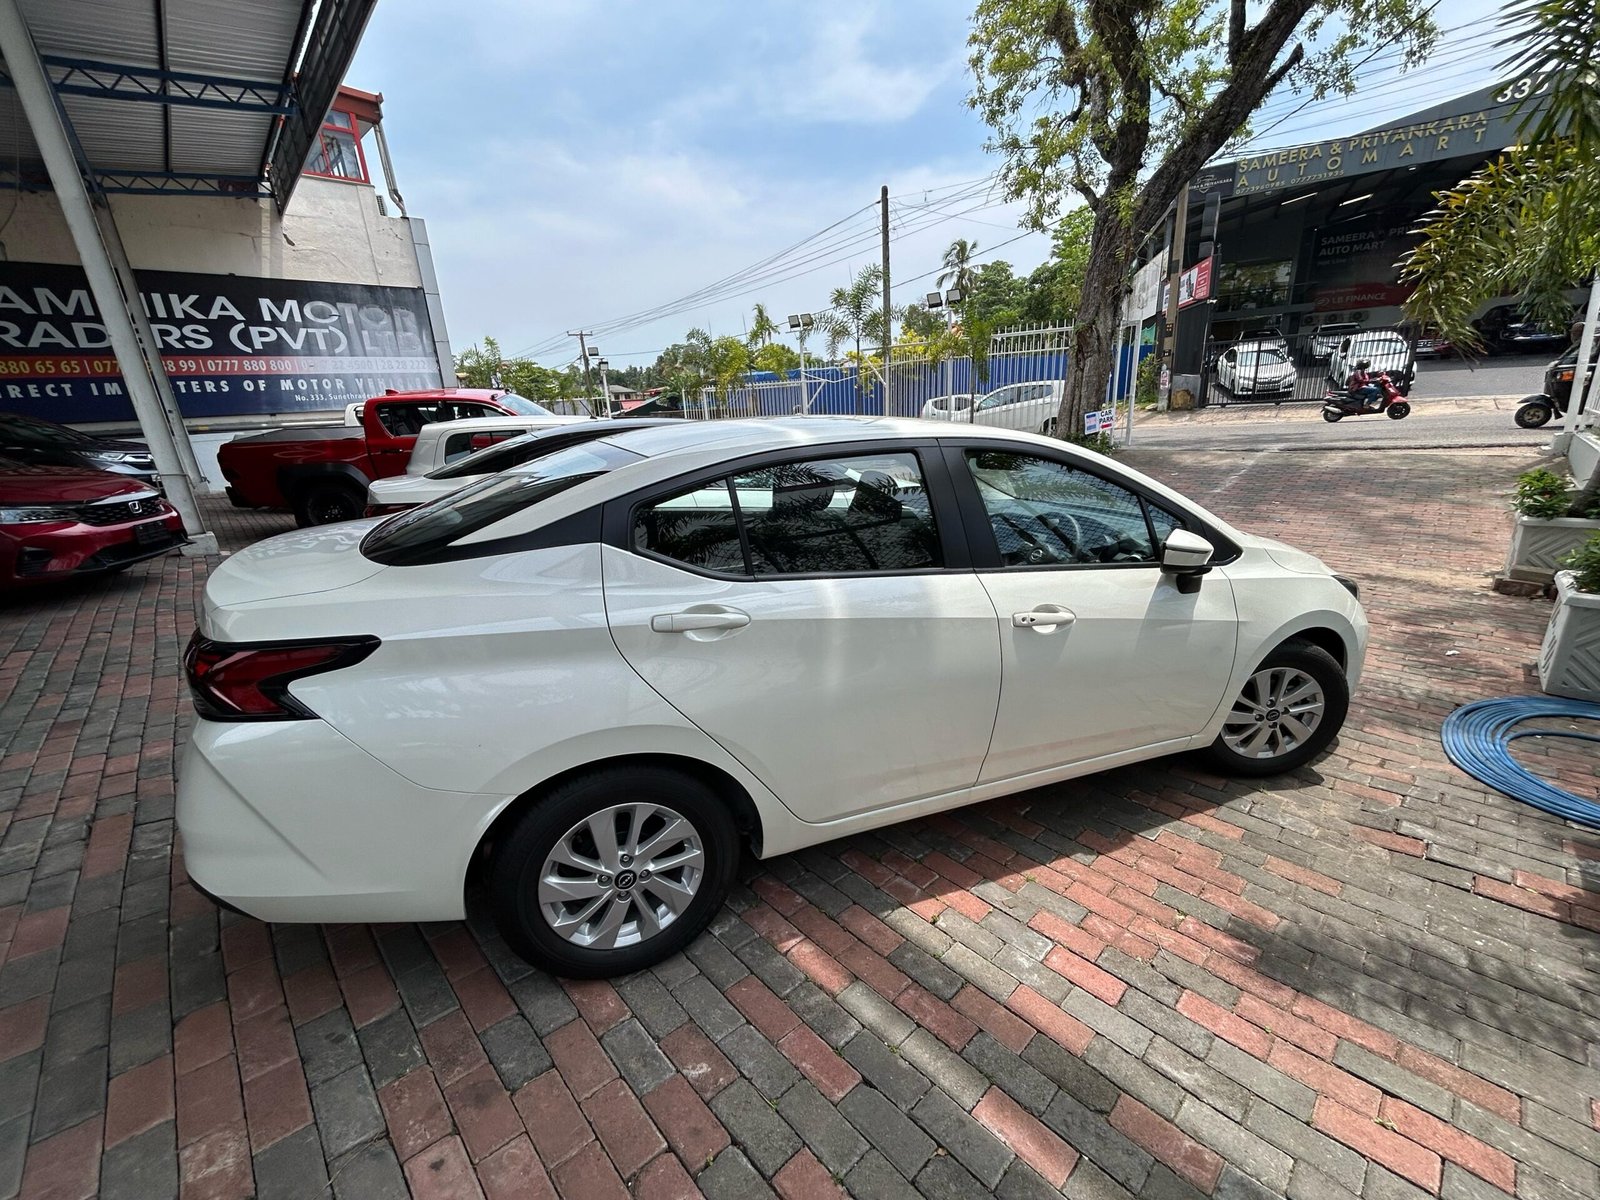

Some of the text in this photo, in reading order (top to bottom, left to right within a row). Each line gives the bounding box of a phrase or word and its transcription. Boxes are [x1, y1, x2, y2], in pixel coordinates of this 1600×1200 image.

[1239, 111, 1488, 173] SAMEERA & PRIYANKARA
[1237, 127, 1487, 188] AUTO MART
[1320, 230, 1376, 247] SAMEERA
[1319, 240, 1386, 257] AUTO MART
[1345, 292, 1387, 303] FINANCE
[258, 297, 418, 328] MOTOR
[0, 320, 214, 350] RADRS
[229, 322, 348, 354] (PVT)
[35, 360, 56, 374] 65
[60, 360, 81, 374] 65
[179, 360, 196, 372] 99
[207, 360, 239, 372] 0777
[243, 360, 267, 371] 880
[270, 360, 292, 371] 800
[0, 383, 73, 398] RECT
[90, 380, 230, 396] IMTERS
[243, 379, 267, 391] OF
[280, 378, 345, 391] MOTOR
[1099, 416, 1114, 424] PARK
[1100, 409, 1112, 417] CAR
